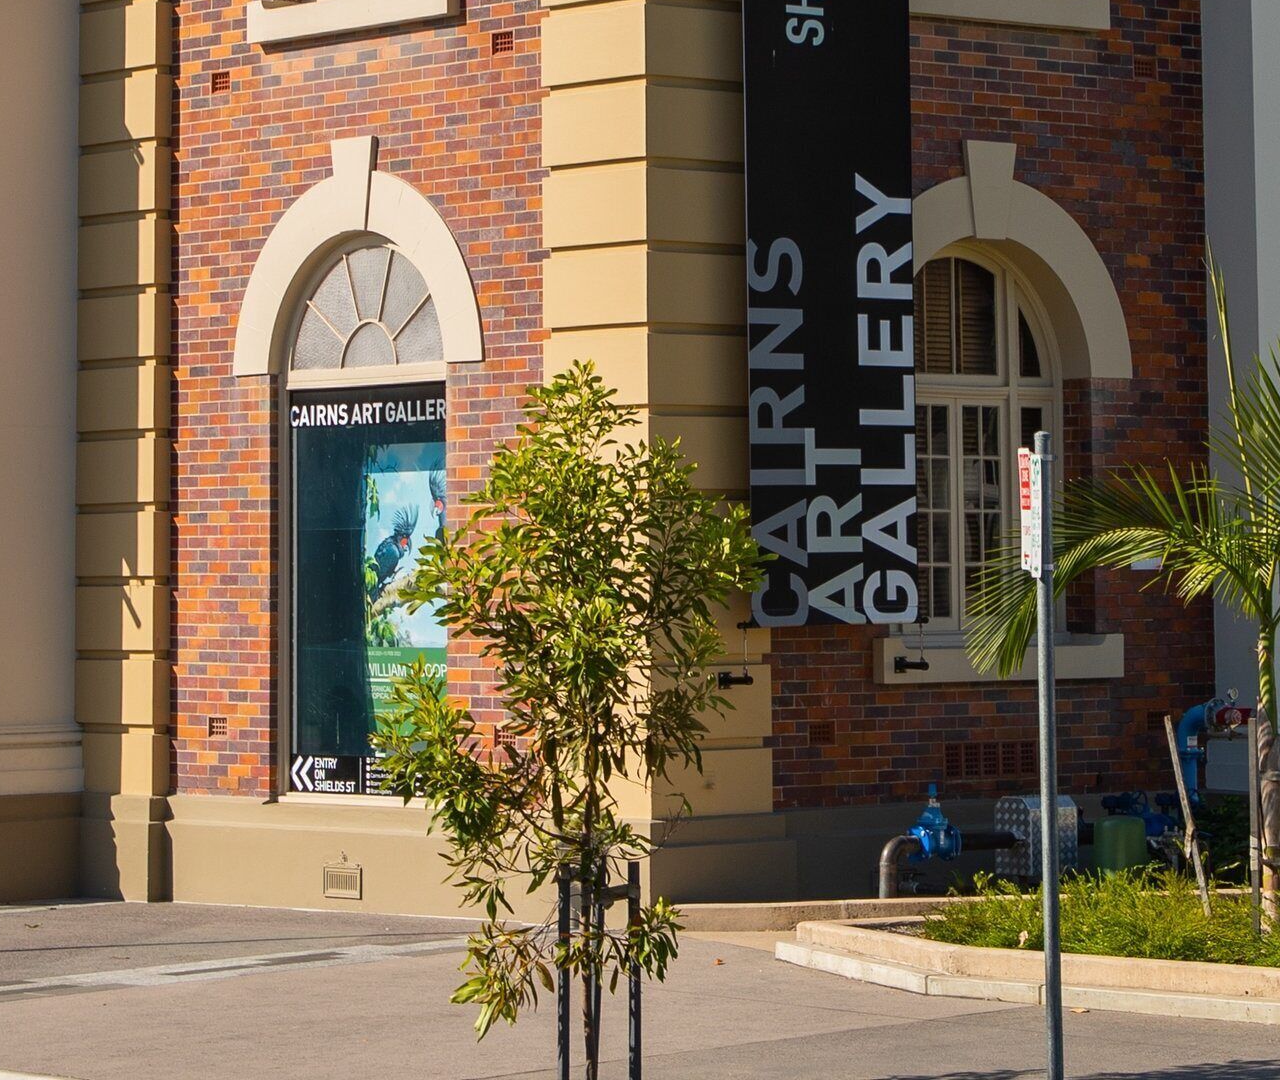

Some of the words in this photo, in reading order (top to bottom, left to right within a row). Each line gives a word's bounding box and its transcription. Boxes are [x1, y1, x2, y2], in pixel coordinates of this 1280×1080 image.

[855, 172, 919, 624] GALLERY
[290, 403, 348, 427] CAIRNS
[351, 402, 383, 425] ART
[747, 237, 808, 627] CAIRNS
[805, 427, 866, 624] ART
[365, 663, 407, 677] WILLIAM
[314, 757, 337, 769] ENTRY
[314, 769, 326, 780] ON
[314, 780, 345, 792] SHIELDS
[346, 781, 356, 793] ST
